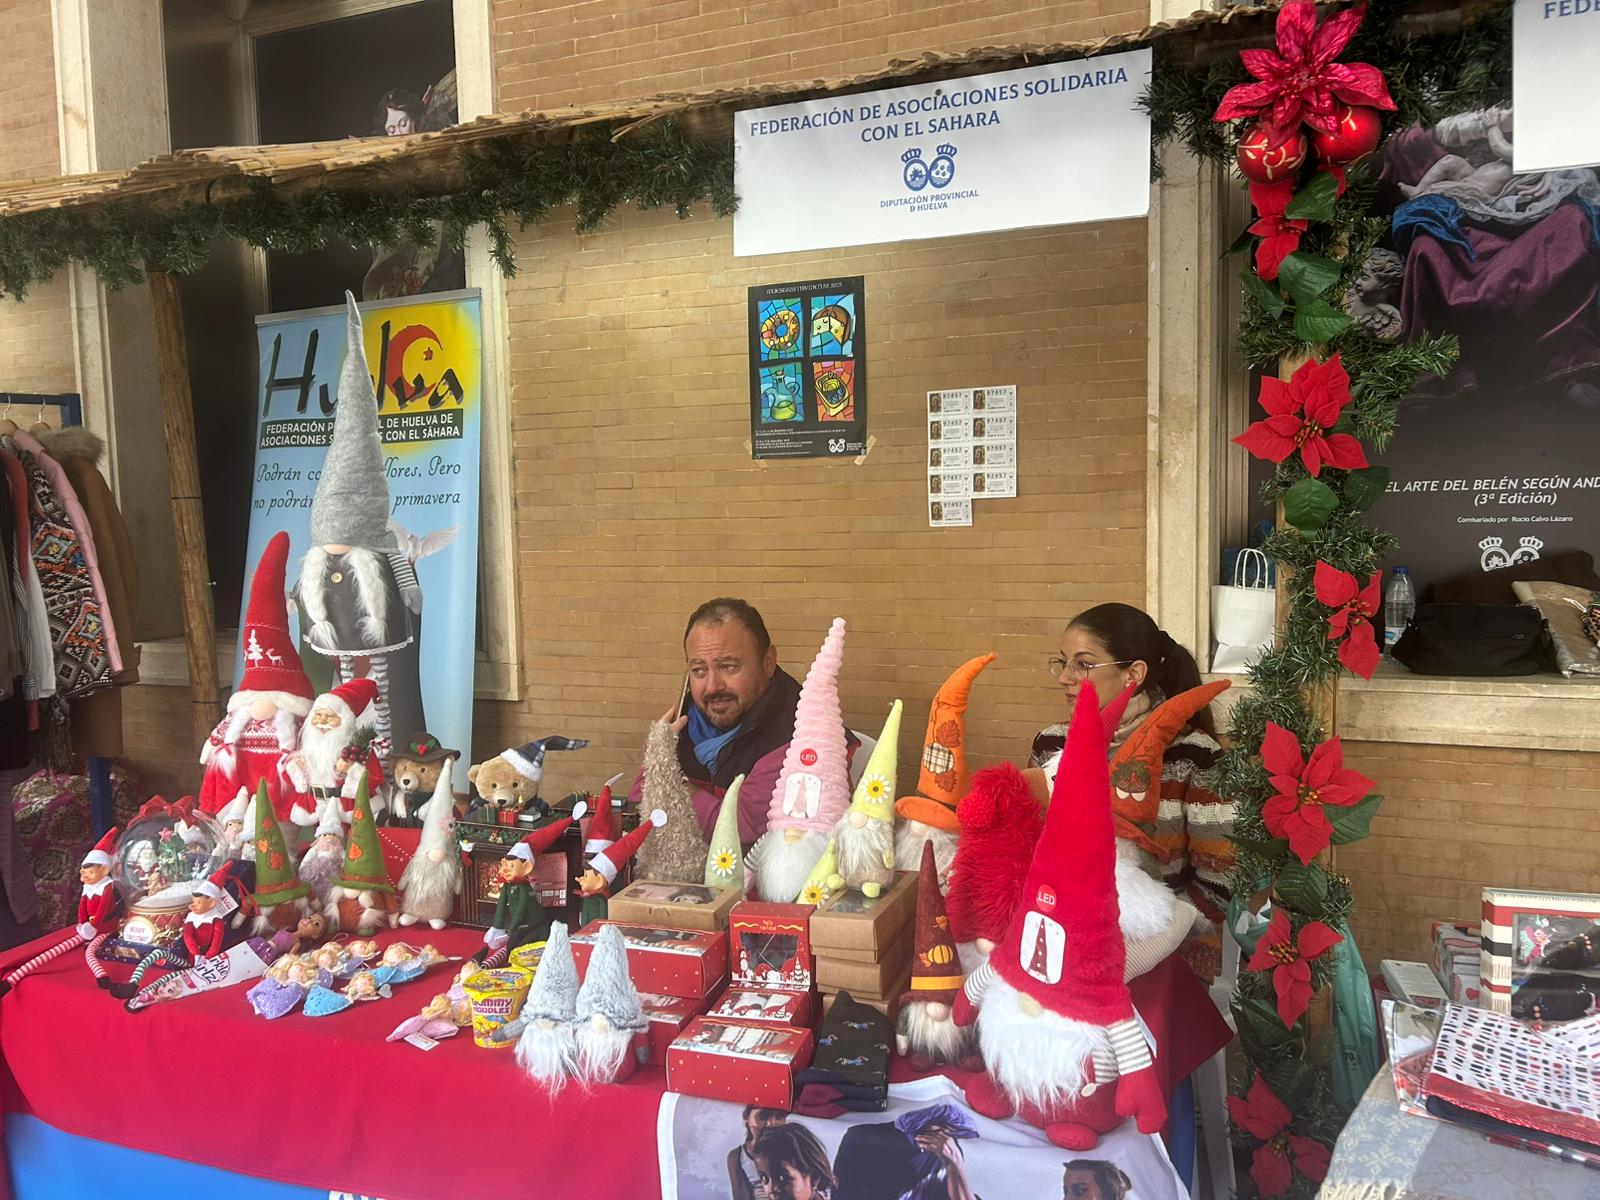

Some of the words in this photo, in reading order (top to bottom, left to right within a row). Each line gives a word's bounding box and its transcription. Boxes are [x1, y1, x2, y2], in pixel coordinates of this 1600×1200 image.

[750, 107, 855, 137] FEDERACIÓN
[859, 105, 882, 121] DE
[885, 84, 1020, 117] ASOCIACIONES
[1023, 67, 1128, 97] SOLIDARIA
[861, 125, 899, 143] CON
[904, 122, 924, 137] EL
[928, 110, 1001, 134] SAHARA
[880, 195, 928, 208] DIPUTACIÓN
[930, 190, 980, 202] PROVINCIAL
[917, 202, 948, 212] HUELVA
[266, 420, 330, 434] FEDERACIÓN
[386, 417, 400, 428] DE
[401, 415, 438, 428] HUELVA
[440, 413, 453, 425] DE
[260, 434, 326, 447] ASOCIACIONES
[385, 428, 406, 439] CON
[408, 427, 420, 439] EL
[422, 424, 460, 438] SÁHARA
[256, 462, 301, 483] Podrán
[428, 455, 461, 476] Pero
[1403, 480, 1440, 492] ARTE
[1443, 479, 1469, 491] DEL
[1473, 476, 1519, 490] BELÉN
[1522, 475, 1572, 489] SEGÚN
[253, 498, 265, 510] no
[391, 492, 461, 516] primavera
[1498, 492, 1557, 506] Edición)
[1038, 892, 1055, 905] LED
